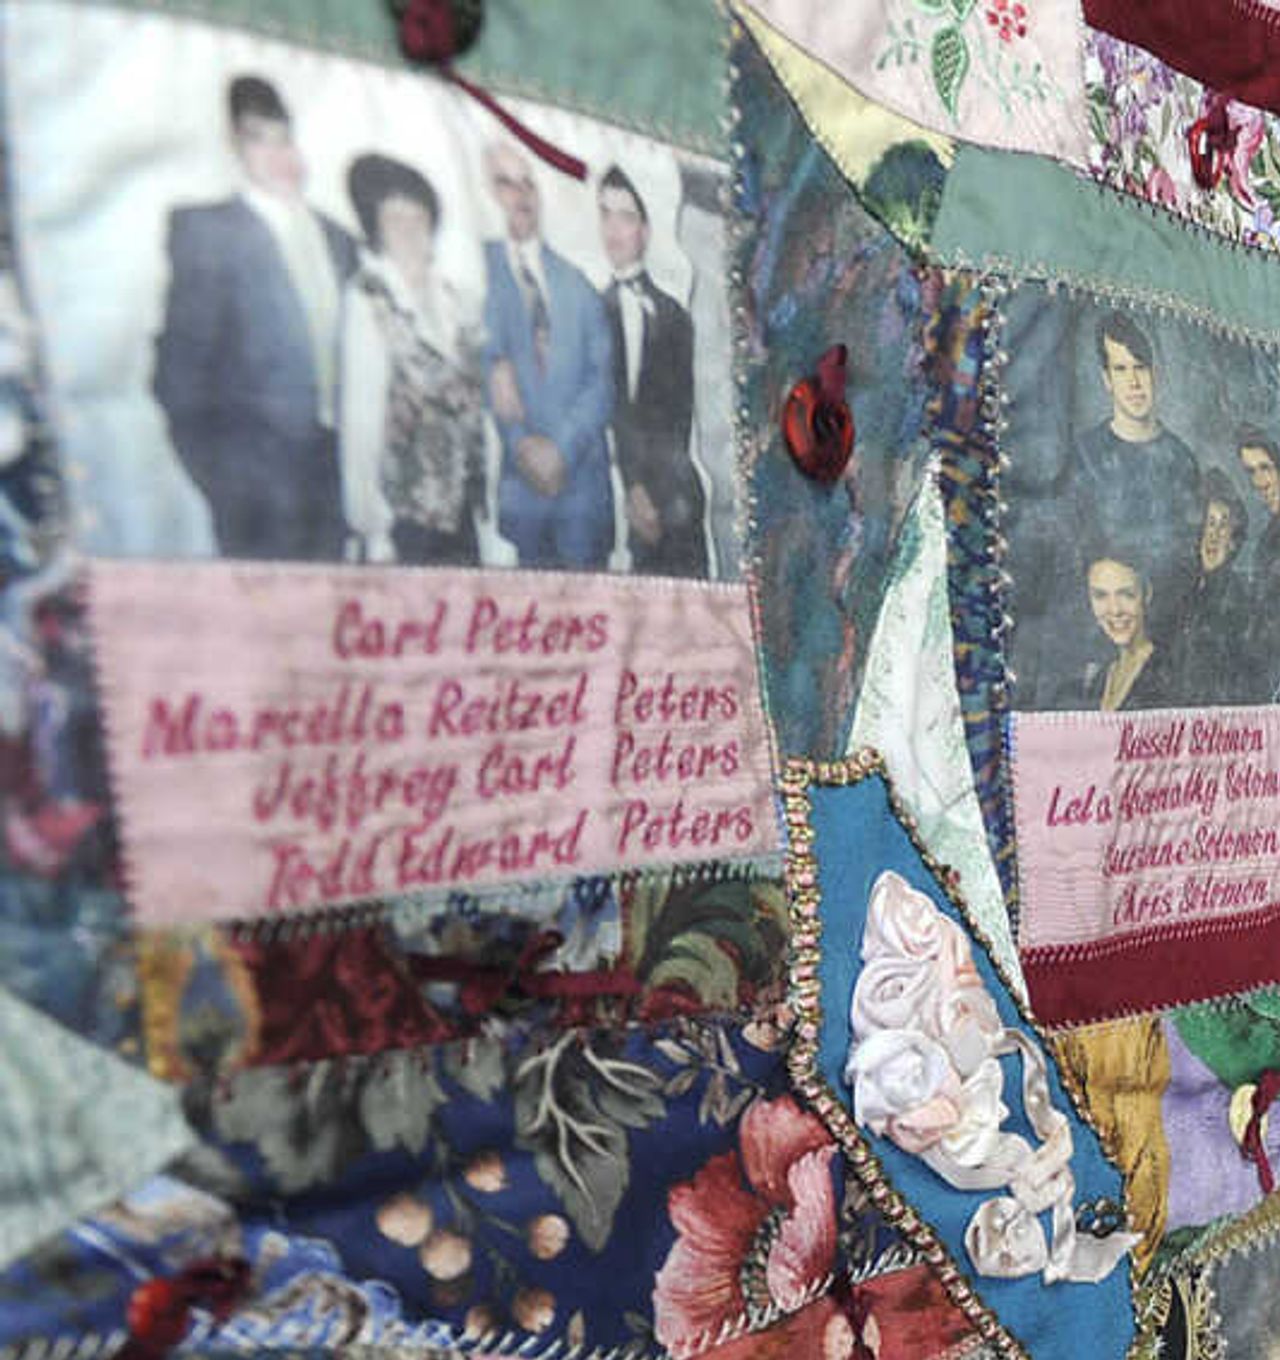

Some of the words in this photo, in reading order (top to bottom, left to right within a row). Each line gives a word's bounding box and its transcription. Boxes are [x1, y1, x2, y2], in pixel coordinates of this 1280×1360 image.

[332, 602, 445, 661] Carl
[463, 597, 611, 659] Peters
[141, 695, 404, 760] Marcella
[428, 672, 590, 740] Reitzel
[612, 669, 740, 725] Peters
[1114, 720, 1185, 762] Russell
[1188, 719, 1264, 757] Solomon
[252, 755, 460, 833] Jeffrey
[475, 740, 577, 800] Carl
[609, 728, 742, 787] Peters
[262, 831, 383, 911] Todd
[394, 812, 587, 890] Edward
[617, 793, 756, 854] Peters
[1192, 823, 1280, 864] Solomon
[1176, 870, 1270, 915] Solomon
